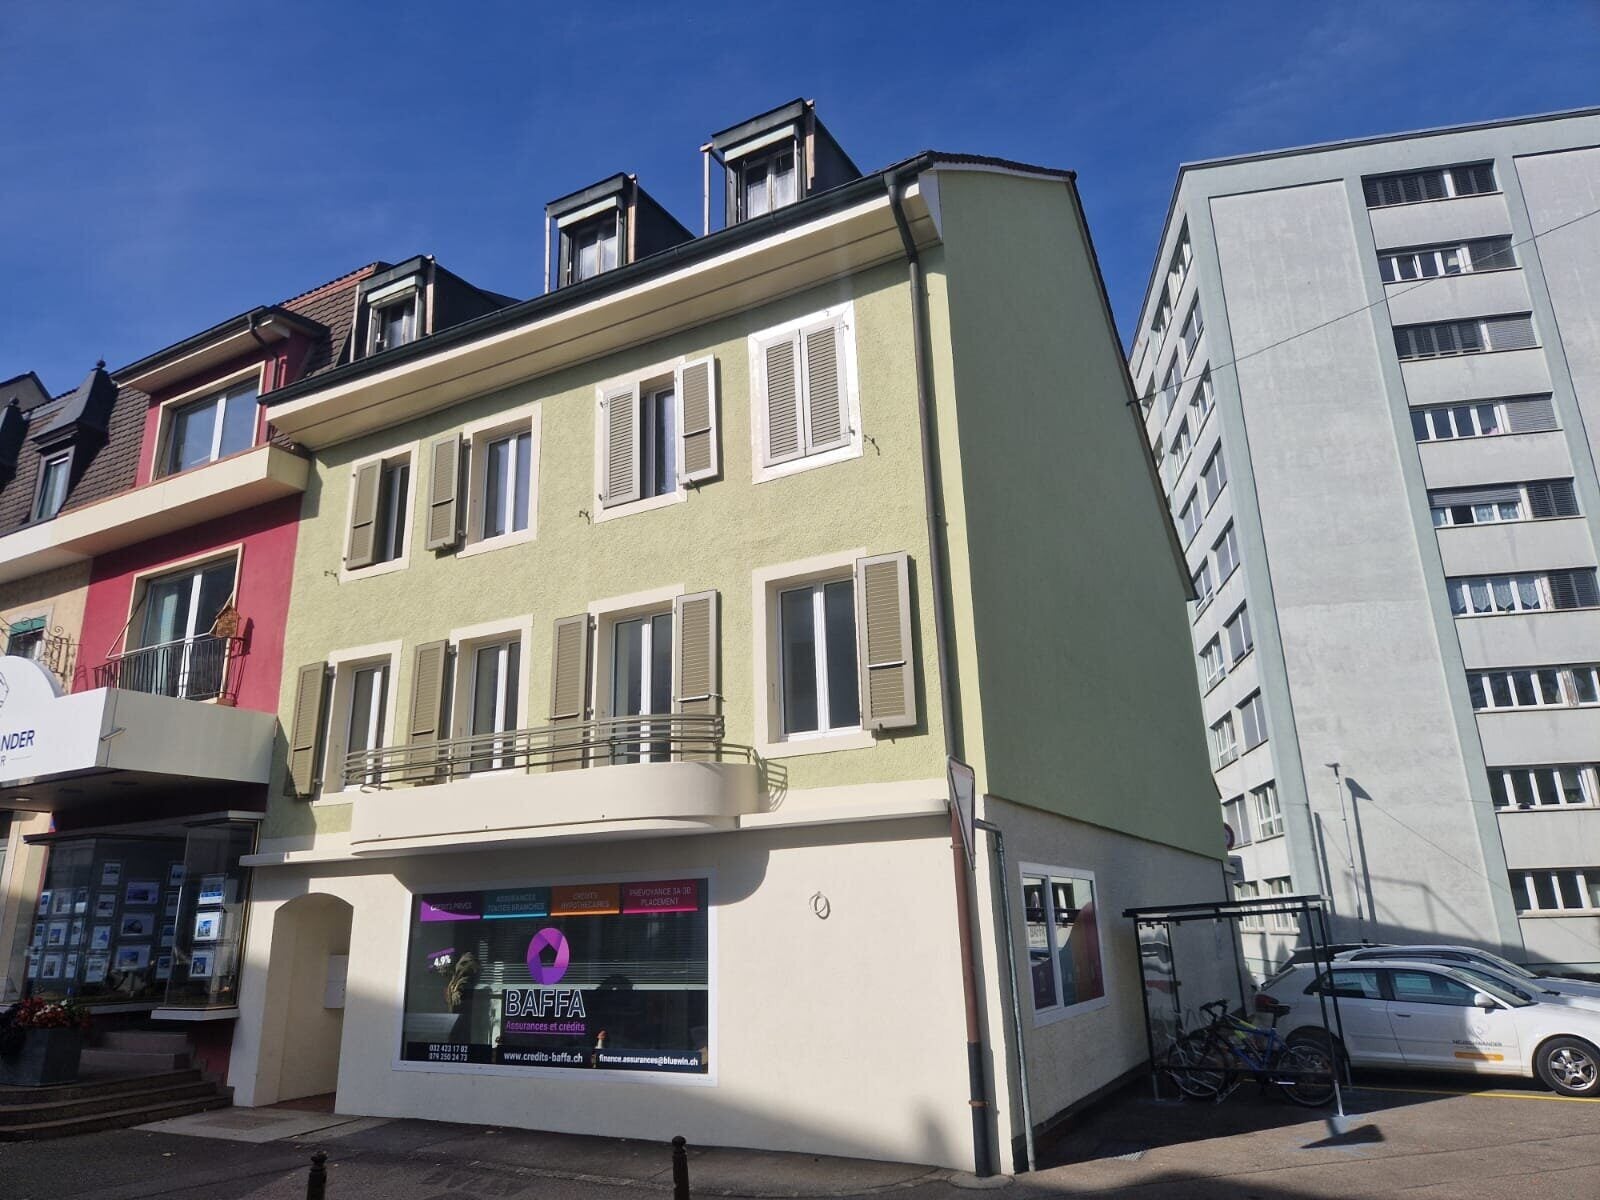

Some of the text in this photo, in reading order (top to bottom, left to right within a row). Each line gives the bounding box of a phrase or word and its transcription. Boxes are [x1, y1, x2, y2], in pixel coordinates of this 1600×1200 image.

[505, 989, 586, 1017] BAFFA
[506, 1021, 585, 1031] Assurances et crédits
[504, 1051, 583, 1063] www.credits-baffa.ch
[599, 1054, 698, 1066] finance.assurances@bluewin.ch
